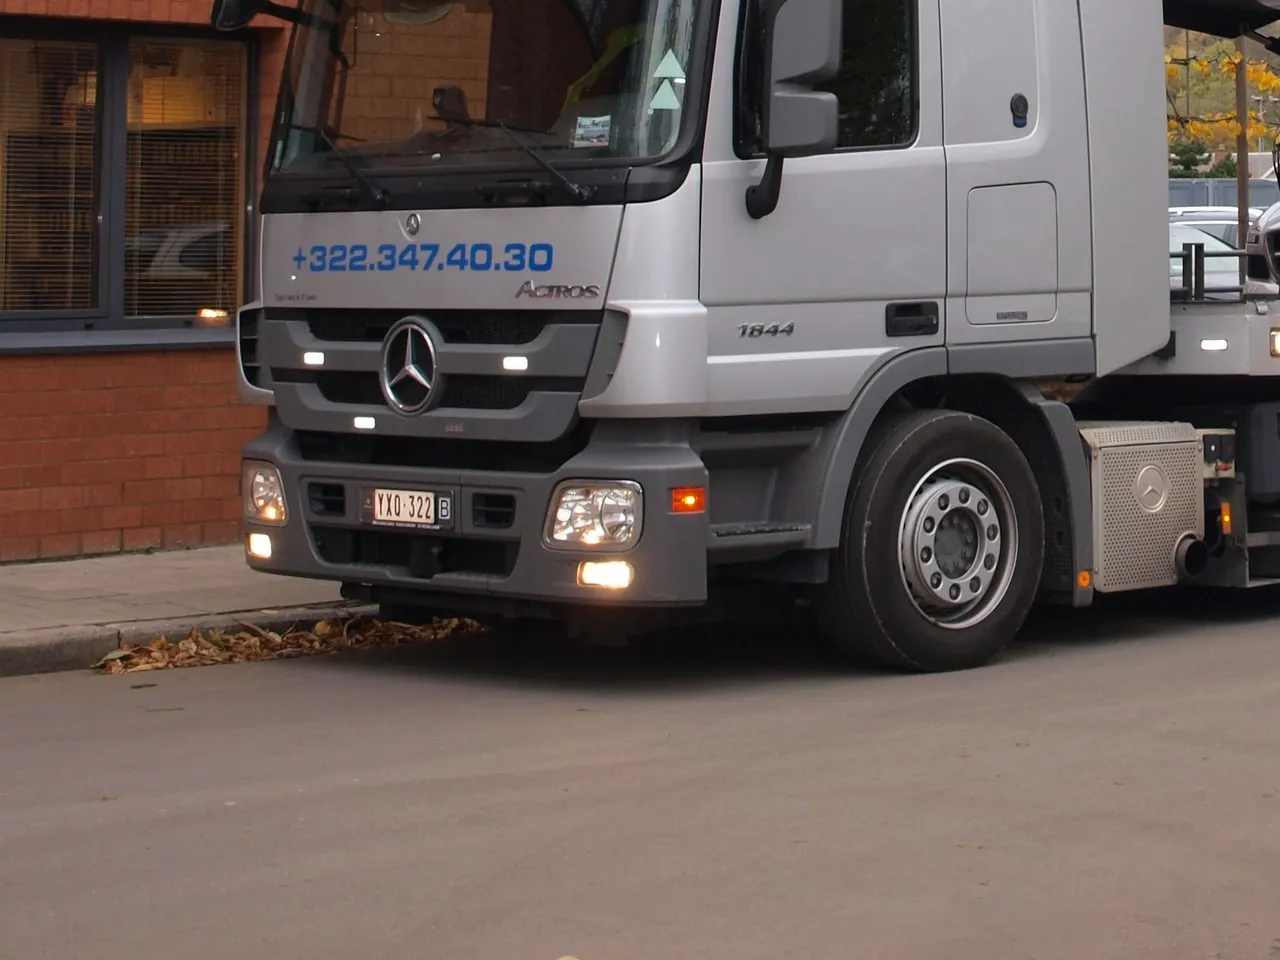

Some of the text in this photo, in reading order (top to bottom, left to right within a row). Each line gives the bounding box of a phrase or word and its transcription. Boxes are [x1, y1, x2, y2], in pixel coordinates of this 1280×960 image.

[292, 243, 554, 272] +322.347.40.30
[737, 322, 795, 338] 1844
[441, 499, 449, 518] B
